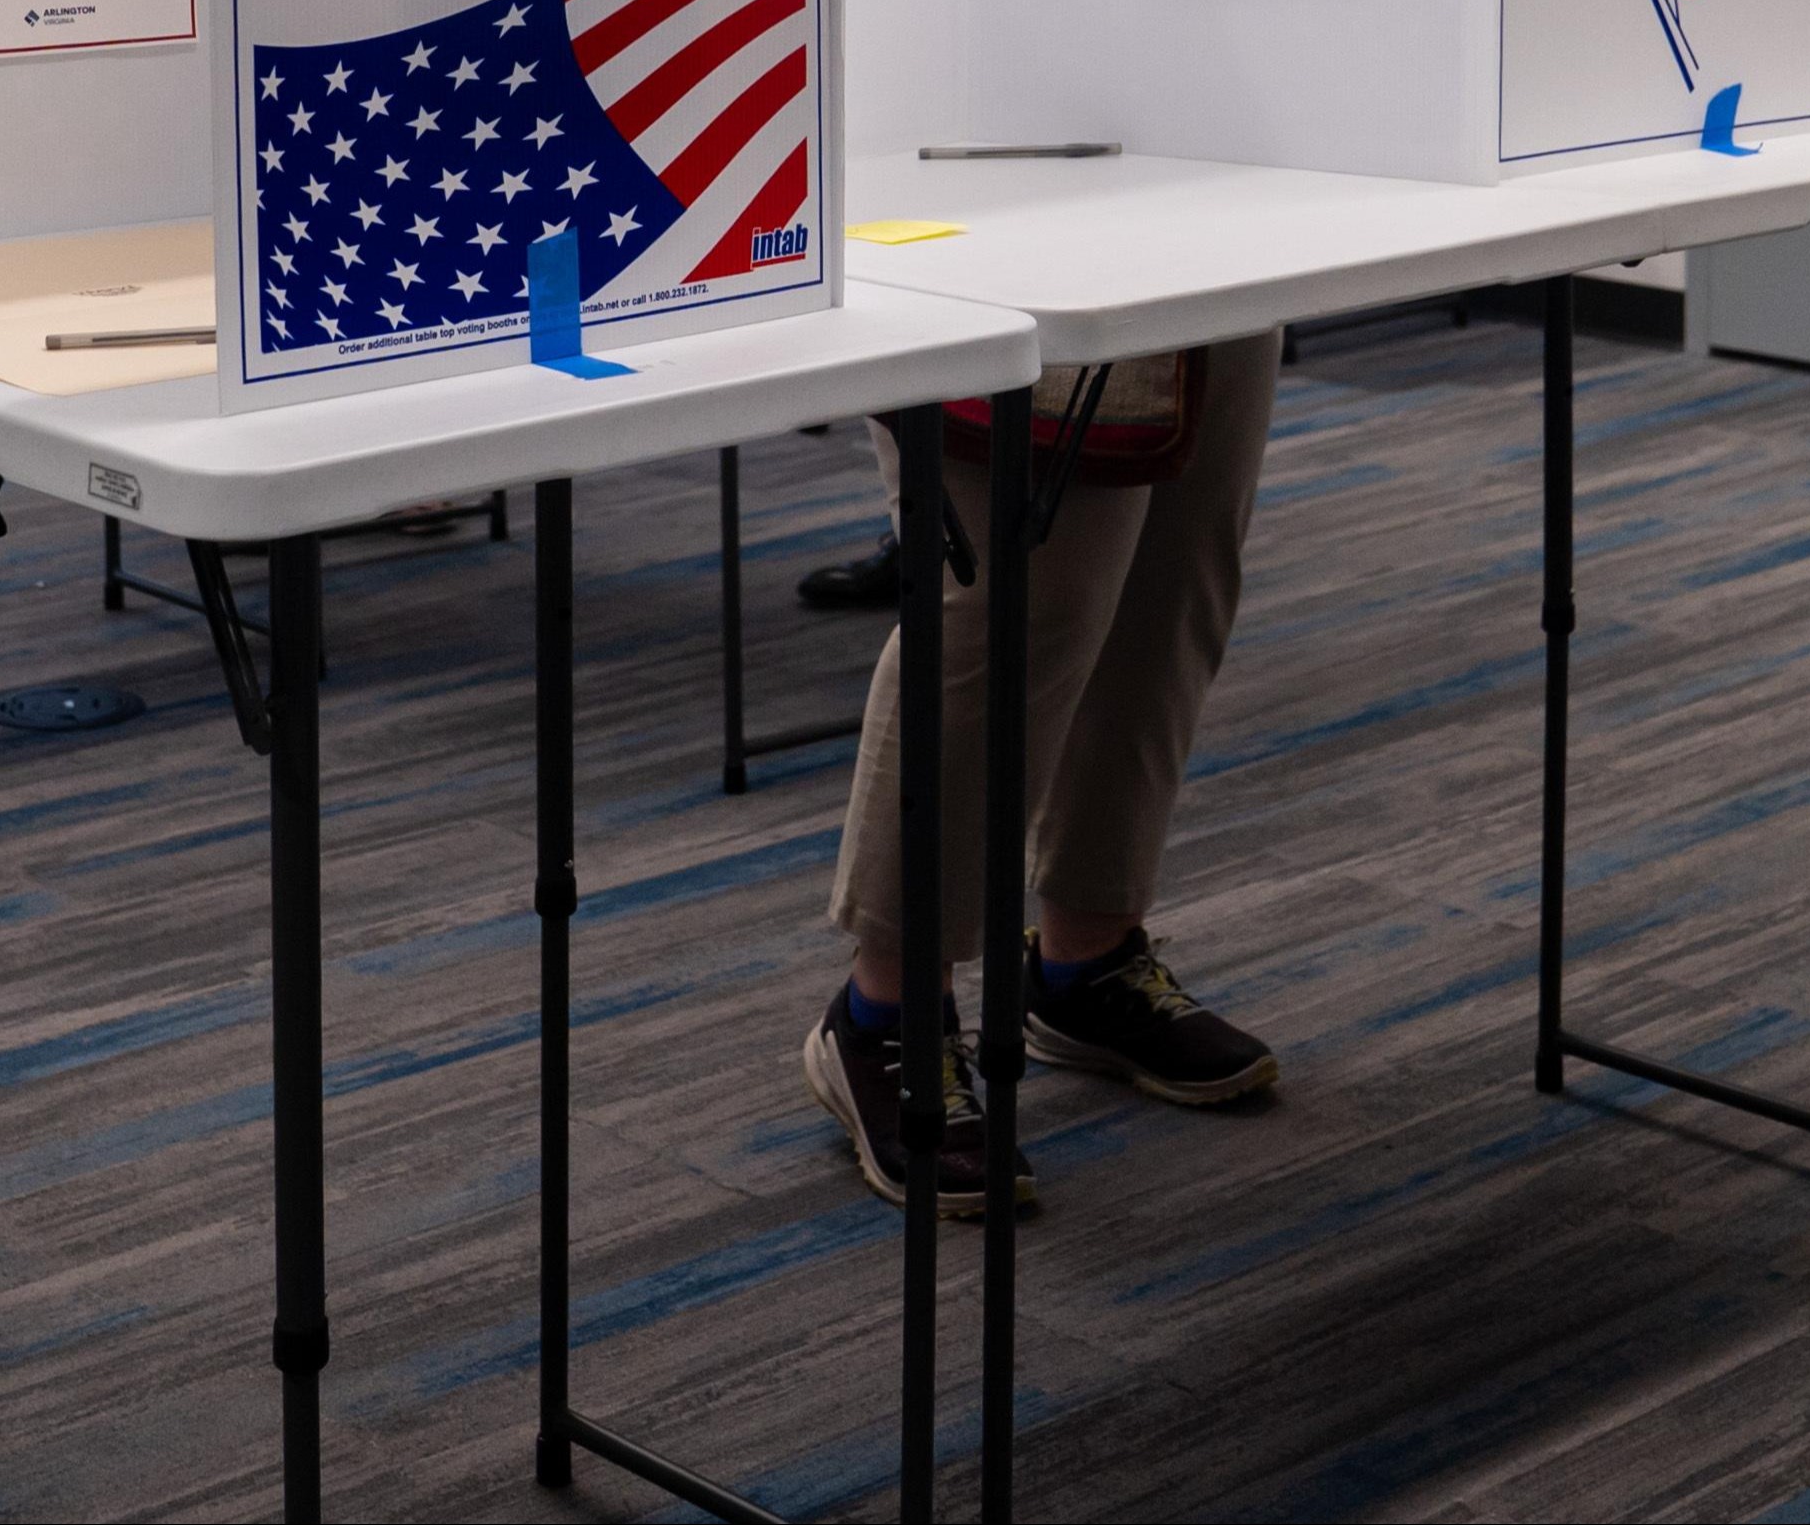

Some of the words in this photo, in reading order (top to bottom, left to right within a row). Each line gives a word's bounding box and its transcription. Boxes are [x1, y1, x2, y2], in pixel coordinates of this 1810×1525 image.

[44, 6, 95, 17] ARLINGTON
[752, 223, 808, 261] intab
[621, 296, 630, 308] or
[632, 291, 646, 305] call
[648, 284, 708, 302] 1.800.232.1872.
[339, 342, 364, 354] Order
[368, 334, 412, 350] additional
[415, 329, 437, 341] table
[440, 326, 454, 339] top
[457, 320, 485, 335] voting
[487, 317, 518, 330] booths
